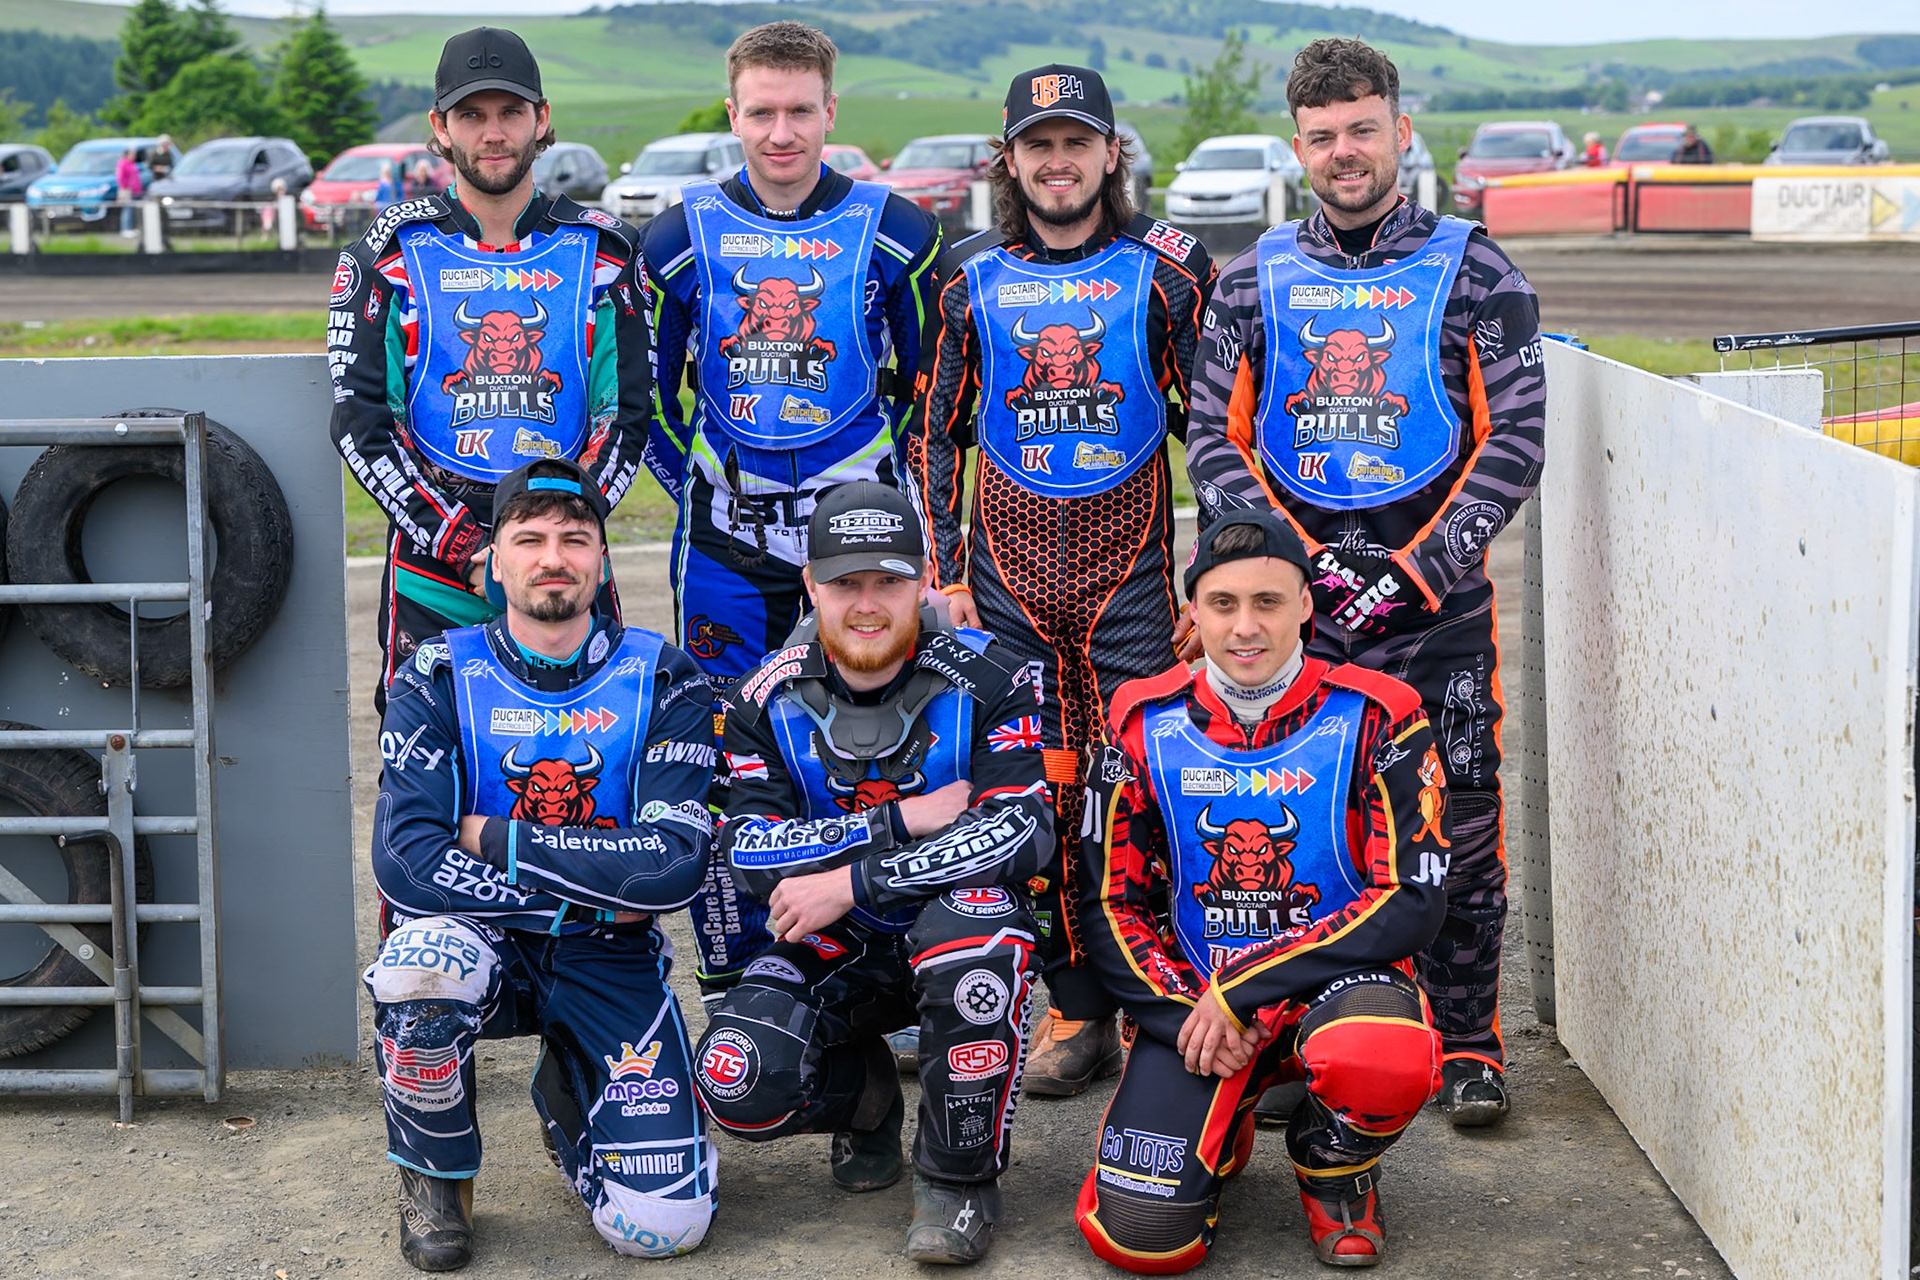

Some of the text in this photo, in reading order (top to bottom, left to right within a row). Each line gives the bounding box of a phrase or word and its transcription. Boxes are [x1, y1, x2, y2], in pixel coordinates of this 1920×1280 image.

[467, 46, 502, 69] alo
[1778, 184, 1865, 208] DUCTAIR
[366, 198, 431, 247] HAGON
[372, 206, 439, 253] SHOCKS
[721, 235, 759, 246] DUCTAIR
[1147, 235, 1185, 260] SHORING
[442, 270, 479, 280] DUCTAIR
[1000, 283, 1037, 296] DUCTAIR
[1292, 287, 1330, 298] DUCTAIR
[748, 341, 803, 352] BUXTON
[475, 375, 532, 385] BUXTON
[727, 358, 827, 391] BULLS
[1034, 388, 1091, 401] BUXTON
[1316, 397, 1373, 407] BUXTON
[451, 391, 556, 427] BULLS
[1016, 404, 1119, 441] BULLS
[1294, 414, 1399, 448] BULLS
[339, 432, 431, 547] HOLLANDS
[370, 455, 415, 507] BILL
[605, 460, 637, 508] BILL
[1454, 505, 1479, 524] Motor
[1481, 504, 1502, 520] Bodies
[1338, 528, 1367, 550] The
[742, 645, 809, 701] SHIMANDY
[916, 650, 976, 690] Finance
[755, 663, 801, 706] RACING
[1224, 682, 1288, 701] INTERNATIONAL
[492, 722, 521, 731] ELECTRICS
[493, 709, 533, 722] DUCTAIR
[1473, 653, 1486, 787] PRESTIGE WHEELS
[1182, 782, 1210, 790] ELECTRICS
[1183, 769, 1222, 782] DUCTAIR
[737, 854, 780, 863] SPECIALIST
[784, 845, 831, 860] MACHINERY
[908, 820, 1017, 874] D-ZIGN
[954, 887, 1004, 899] STS
[1222, 890, 1283, 902] BUXTON
[951, 901, 1014, 915] TYRE SERVICES
[1204, 906, 1312, 939] BULLS
[709, 1031, 754, 1053] STAKEFORD
[704, 1049, 746, 1078] STS
[955, 1046, 1001, 1069] RSN
[605, 1078, 679, 1104] mpec
[699, 1070, 748, 1098] TYRE SERVICES
[948, 1096, 993, 1109] EASTERN
[959, 1133, 989, 1148] POINT
[1102, 1125, 1187, 1178] Co Tops
[1145, 1182, 1175, 1198] Worktops
